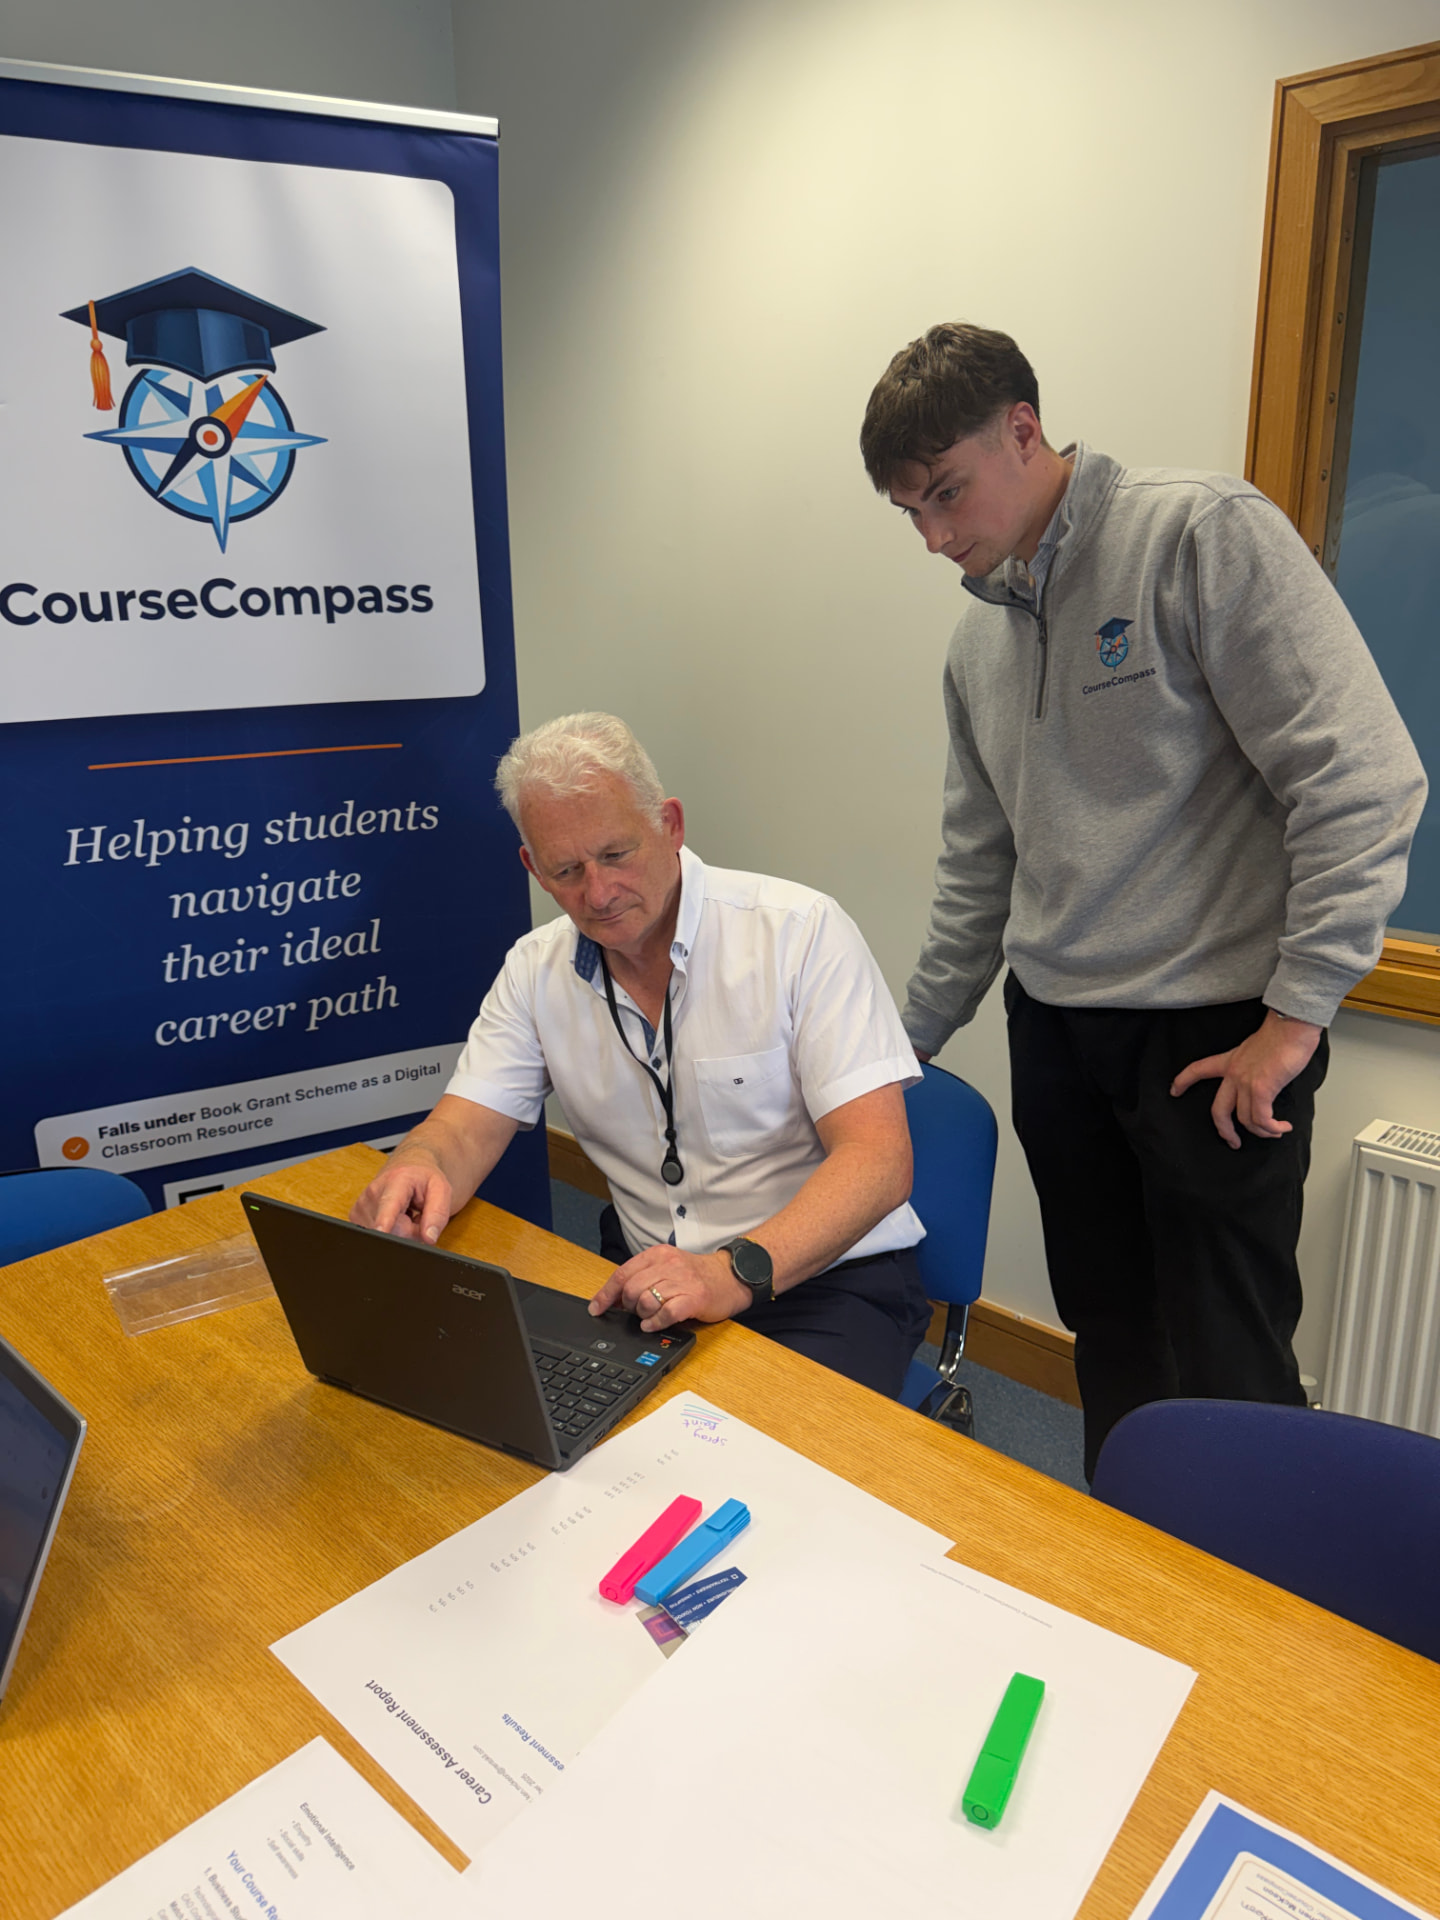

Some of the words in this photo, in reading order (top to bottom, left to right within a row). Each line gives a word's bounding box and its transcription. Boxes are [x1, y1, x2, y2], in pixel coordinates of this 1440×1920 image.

[0, 578, 434, 626] CourseCompass
[1082, 667, 1156, 695] CourseCompass
[63, 815, 250, 867] Helping
[263, 800, 440, 846] students
[169, 868, 362, 918] navigate
[162, 937, 269, 983] their
[280, 918, 382, 967] ideal
[155, 1003, 297, 1046] career
[305, 976, 400, 1032] path
[98, 1121, 141, 1140] Falls
[144, 1111, 196, 1130] under
[200, 1102, 243, 1120] Book
[246, 1093, 292, 1112] Grant
[295, 1079, 358, 1102] Scheme
[361, 1076, 379, 1089] as
[382, 1072, 392, 1084] a
[395, 1062, 442, 1082] Digital
[101, 1131, 193, 1159] Classroom
[196, 1116, 274, 1141] Resource
[452, 1283, 486, 1301] acer
[364, 1679, 401, 1713] Report
[395, 1708, 458, 1769] Assessment
[502, 1712, 532, 1743] Results
[529, 1738, 565, 1771] essment
[455, 1767, 492, 1804] Career
[300, 1802, 329, 1836] Emotional
[323, 1832, 355, 1871] Intelligence
[208, 1873, 233, 1908] Business
[226, 1849, 246, 1874] Your
[241, 1872, 268, 1908] Course
[1262, 1886, 1297, 1911] McKeon
